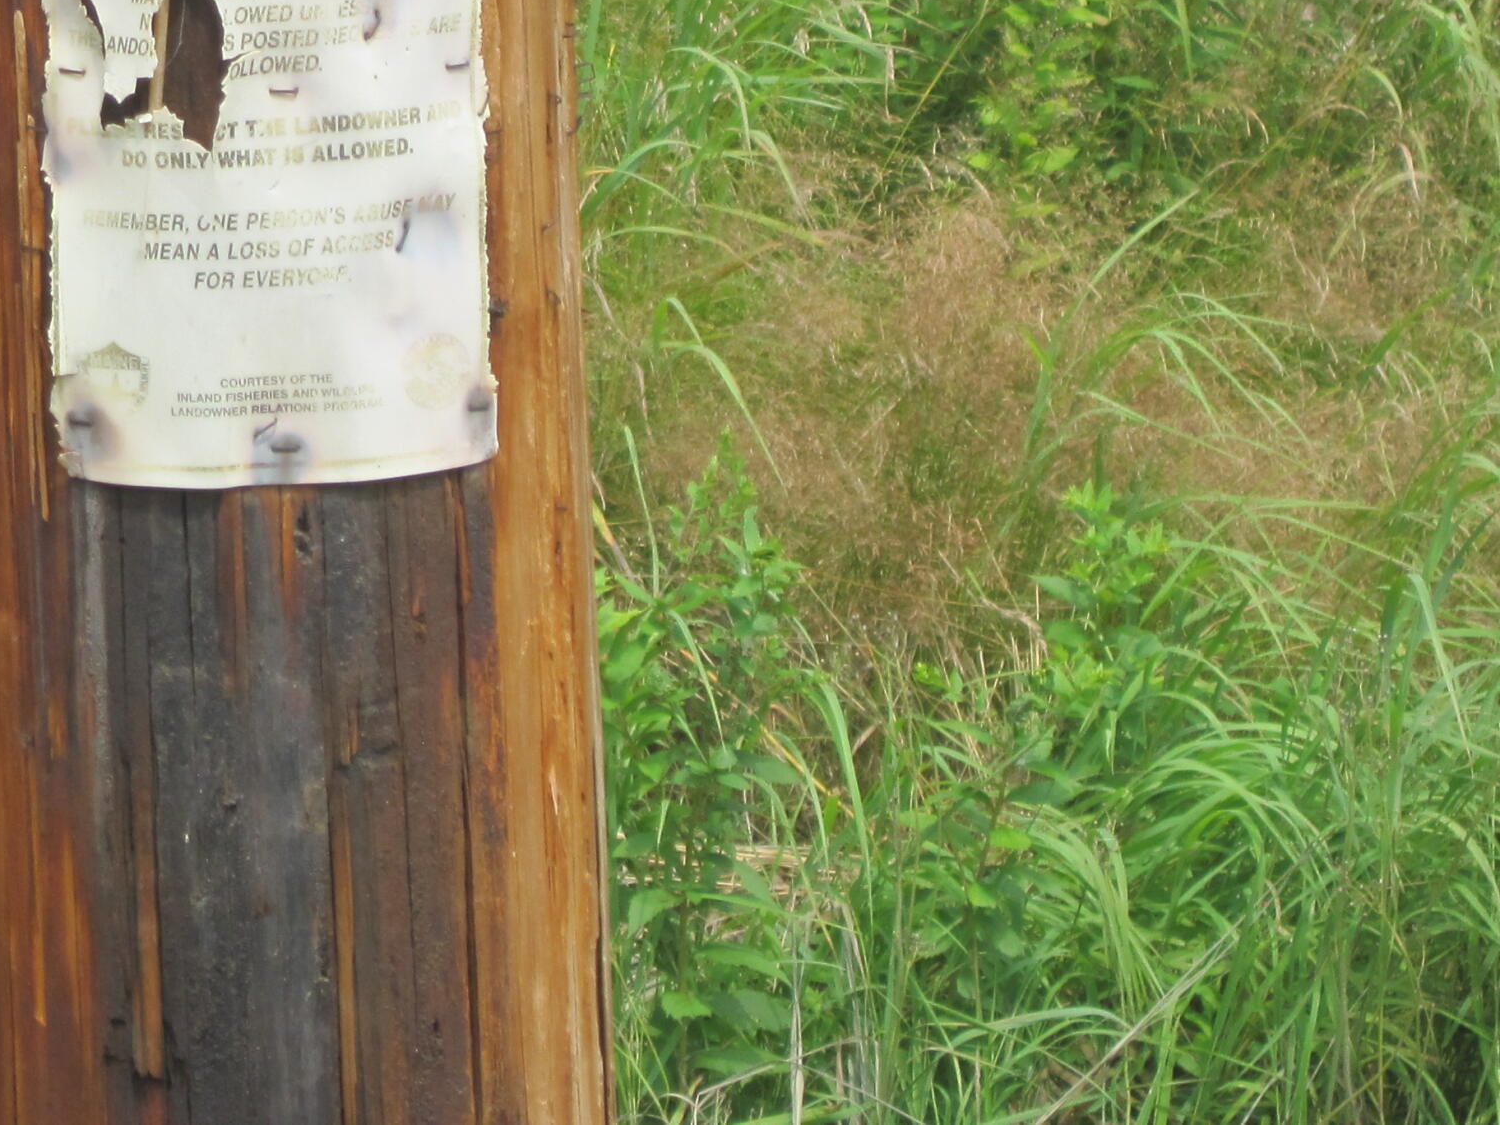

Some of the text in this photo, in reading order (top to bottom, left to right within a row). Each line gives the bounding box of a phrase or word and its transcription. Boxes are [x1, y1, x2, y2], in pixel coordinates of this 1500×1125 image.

[230, 55, 323, 81] OLLOWED.
[294, 106, 422, 134] LANDOWNER
[122, 149, 148, 168] DO
[154, 150, 209, 169] ONLY
[217, 147, 277, 169] WHAT
[311, 137, 414, 163] ALLOWED.
[143, 242, 201, 261] MEAN
[206, 242, 220, 261] A
[227, 240, 282, 262] LOSS
[288, 238, 315, 257] OF
[193, 271, 236, 290] FOR
[219, 373, 333, 389] COURTESY OF THE
[177, 391, 223, 405] INLAND
[225, 388, 289, 403] FISHERIES
[292, 387, 318, 400] AND
[170, 404, 248, 418] LANDOWNER
